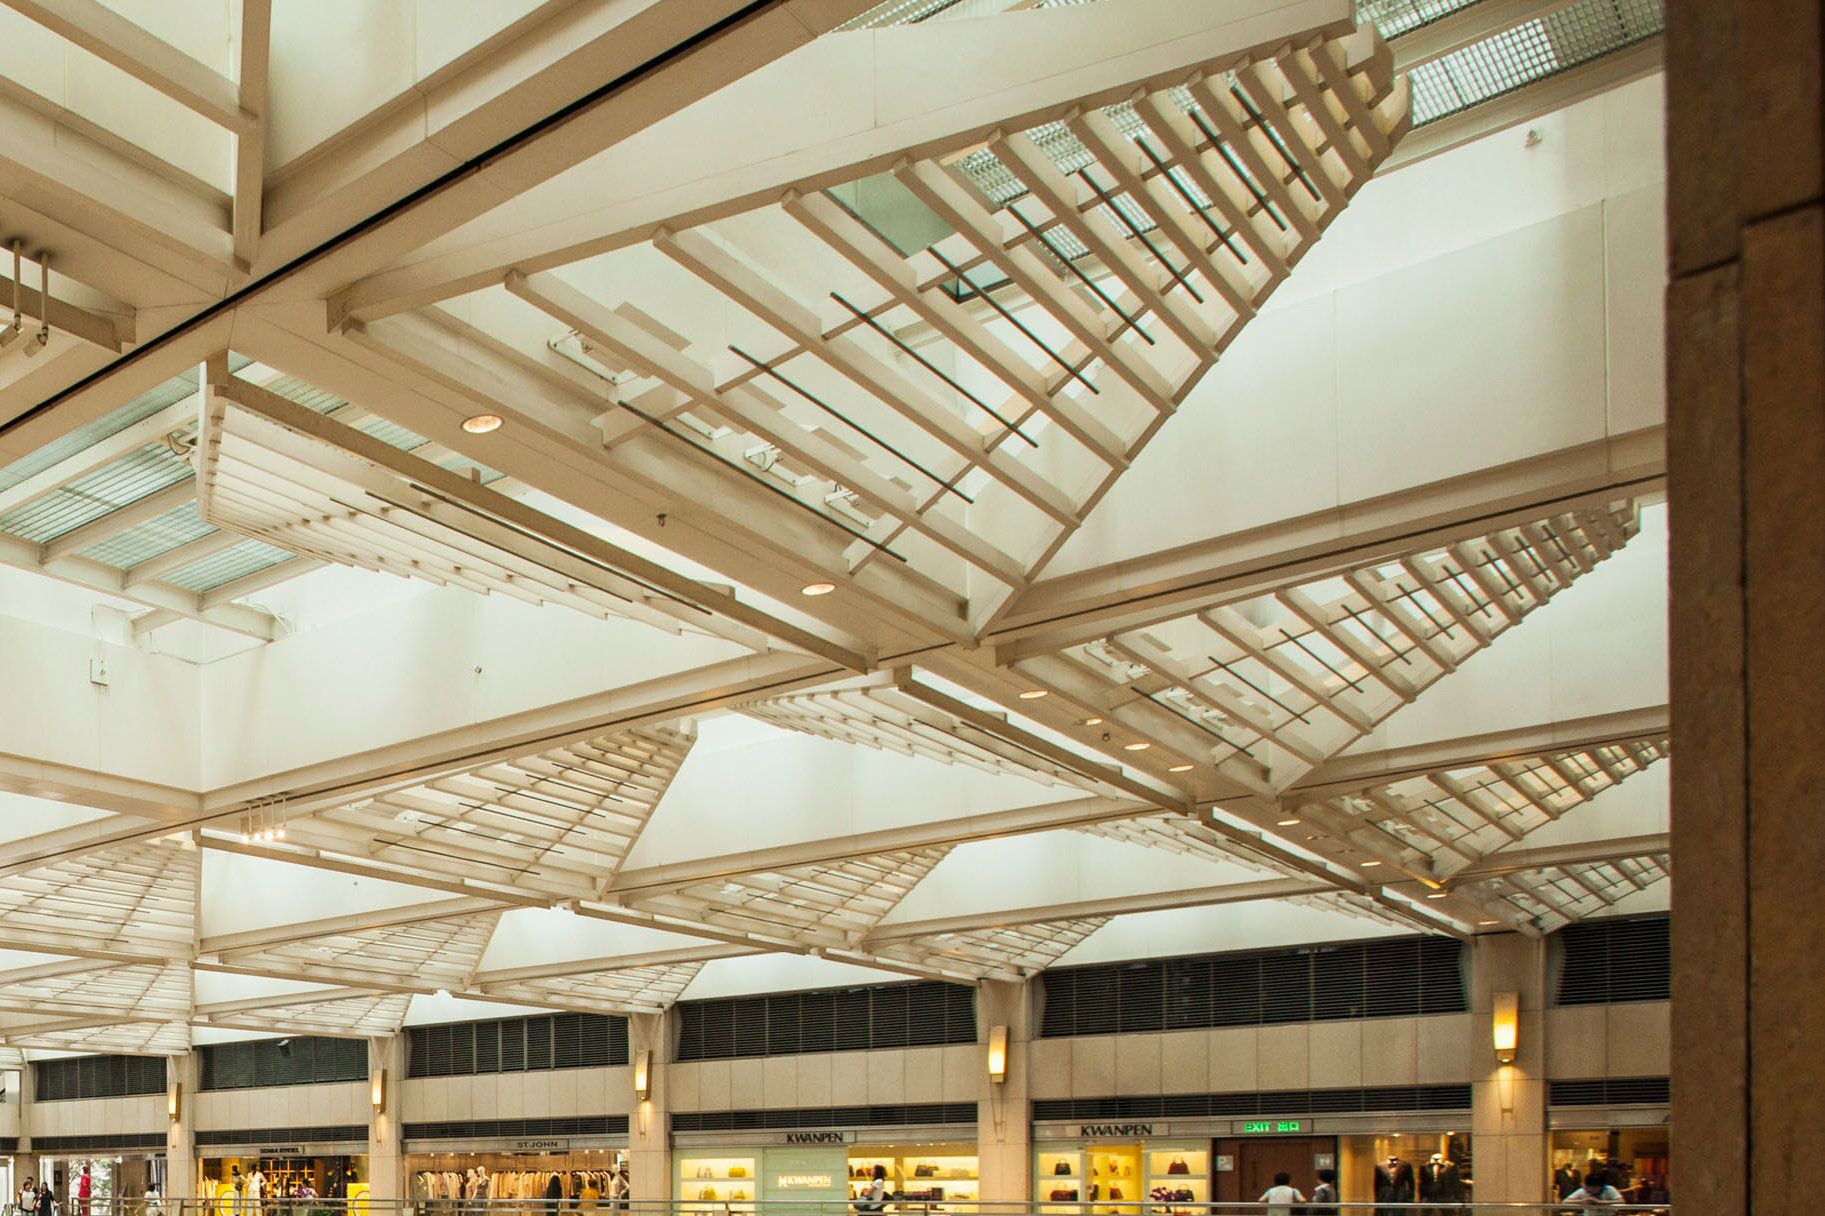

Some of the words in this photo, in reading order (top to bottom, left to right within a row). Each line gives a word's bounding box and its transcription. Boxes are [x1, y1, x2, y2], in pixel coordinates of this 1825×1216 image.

[1081, 1124, 1153, 1136] KWANPEN
[1244, 1122, 1271, 1132] EXIT
[1277, 1121, 1300, 1132] 出口
[786, 1132, 843, 1144] KWANPEN
[787, 1175, 832, 1185] KWANPEN
